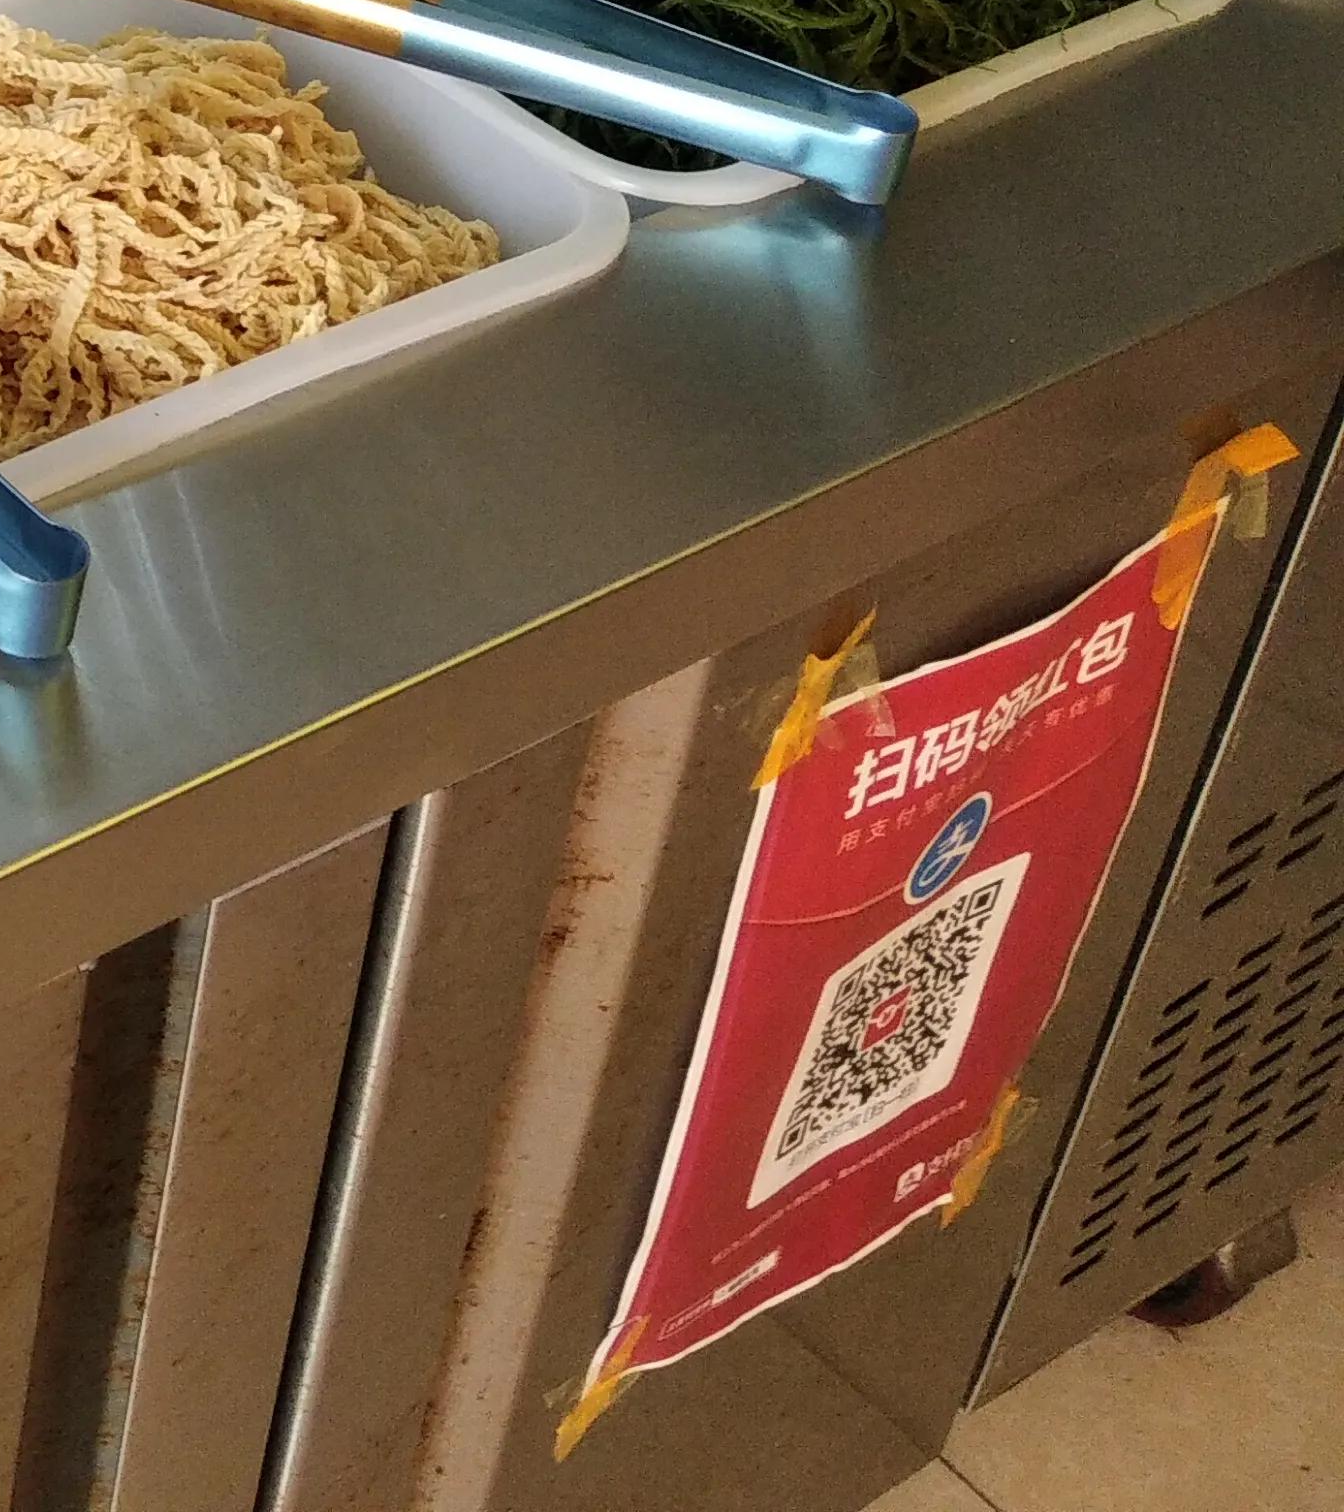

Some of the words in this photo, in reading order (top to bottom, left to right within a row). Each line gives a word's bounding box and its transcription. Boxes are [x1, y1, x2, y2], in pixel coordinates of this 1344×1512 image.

[844, 611, 1135, 820] 扫码领红包
